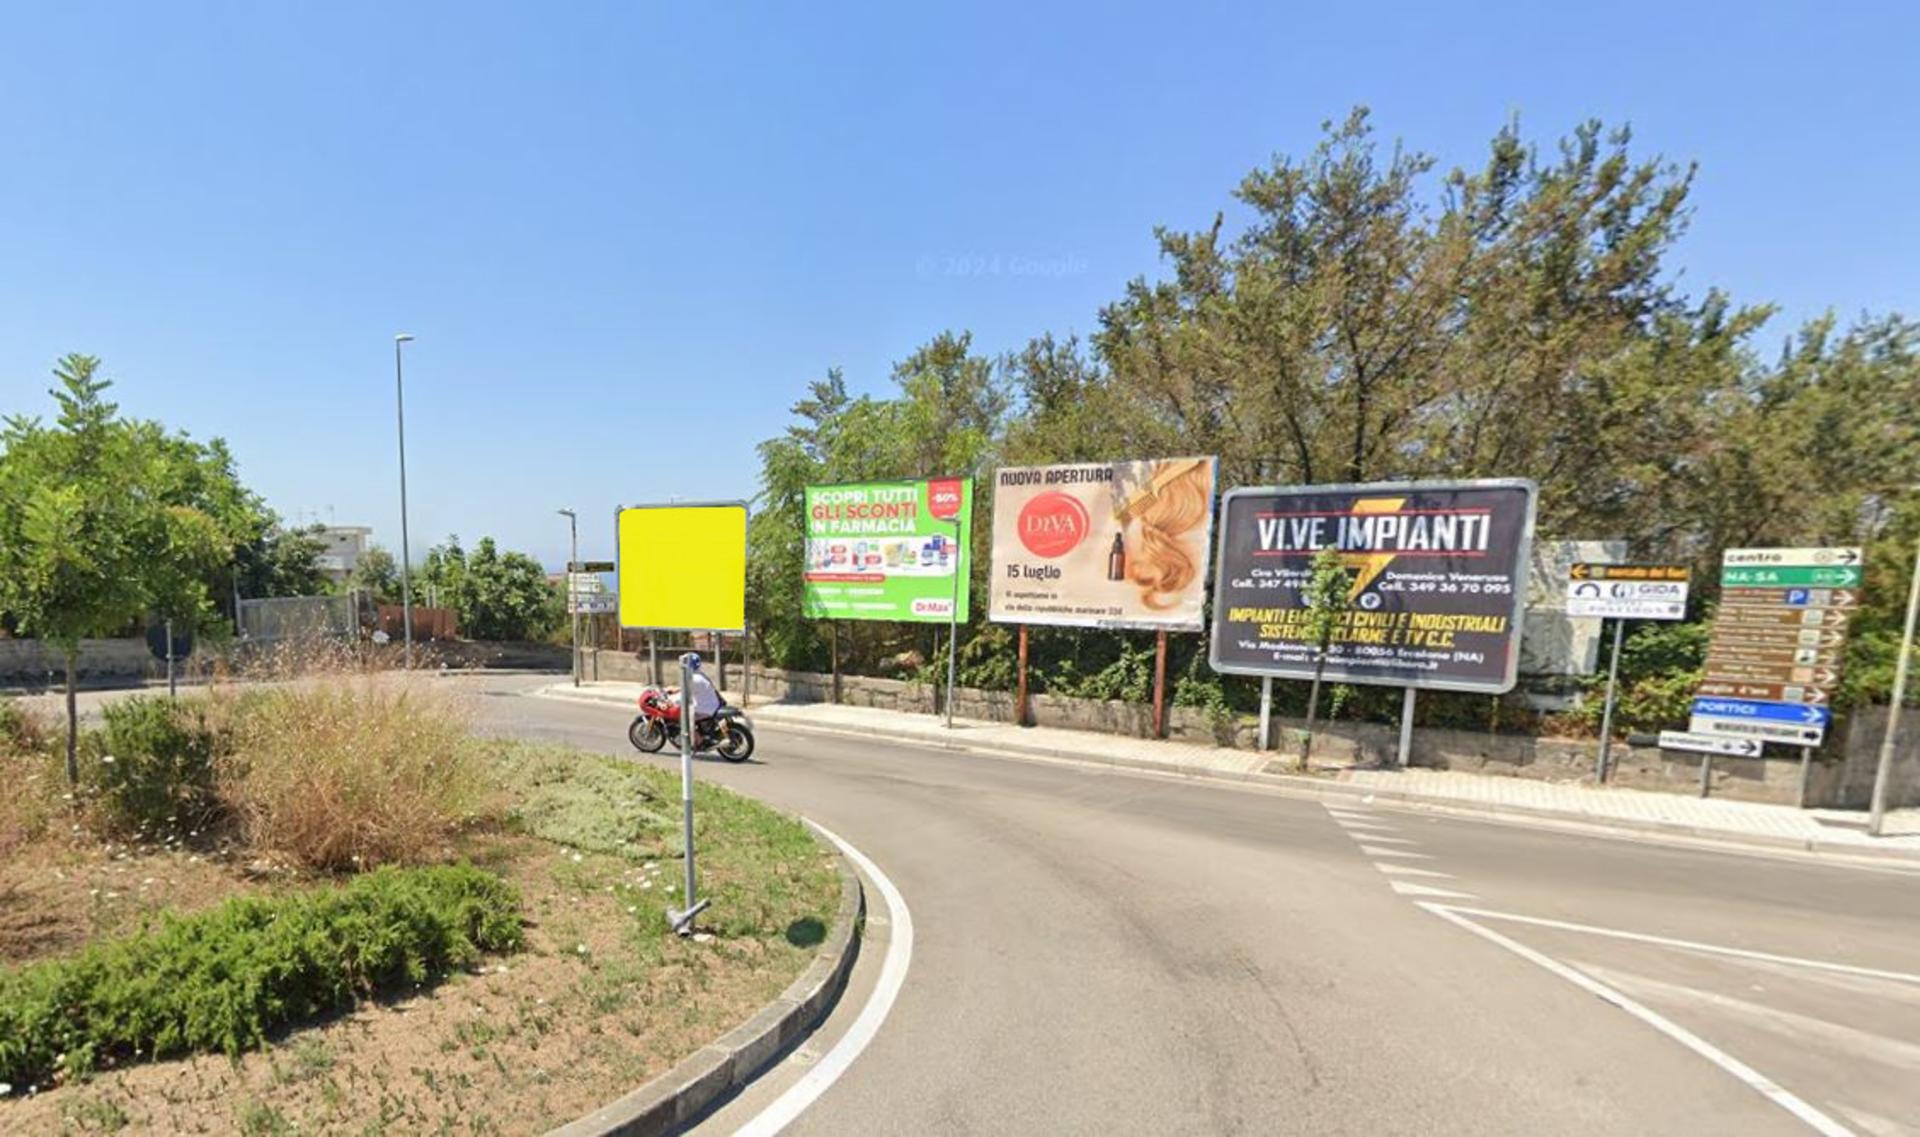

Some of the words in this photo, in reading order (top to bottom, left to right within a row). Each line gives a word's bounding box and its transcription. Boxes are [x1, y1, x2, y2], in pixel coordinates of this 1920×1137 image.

[1001, 471, 1041, 486] NUOVA
[1045, 468, 1114, 484] APERTURA
[812, 490, 868, 504] SCOPRI
[873, 488, 918, 502] TUTTI
[812, 504, 840, 520] GLI
[846, 502, 917, 519] SCONTI
[812, 520, 826, 533] IN
[831, 518, 917, 533] FARMACIA
[1258, 517, 1326, 551] VI.VE
[1337, 514, 1492, 551] IMPIANTI
[1726, 553, 1783, 562] centro
[1007, 564, 1020, 579] 15
[1024, 564, 1062, 581] luglio
[1409, 582, 1437, 592] 349
[1439, 583, 1458, 592] 36
[1461, 583, 1480, 593] 70
[1483, 584, 1511, 594] 095
[1229, 606, 1285, 624] IMPIANTI
[1354, 611, 1395, 628] CIVILI
[1396, 612, 1407, 628] E
[1409, 612, 1506, 633] INDUSTRIALI
[1391, 629, 1401, 644] E
[1238, 640, 1257, 650] Via
[1453, 651, 1485, 664] (NA)
[1697, 701, 1757, 715] PORTICI
